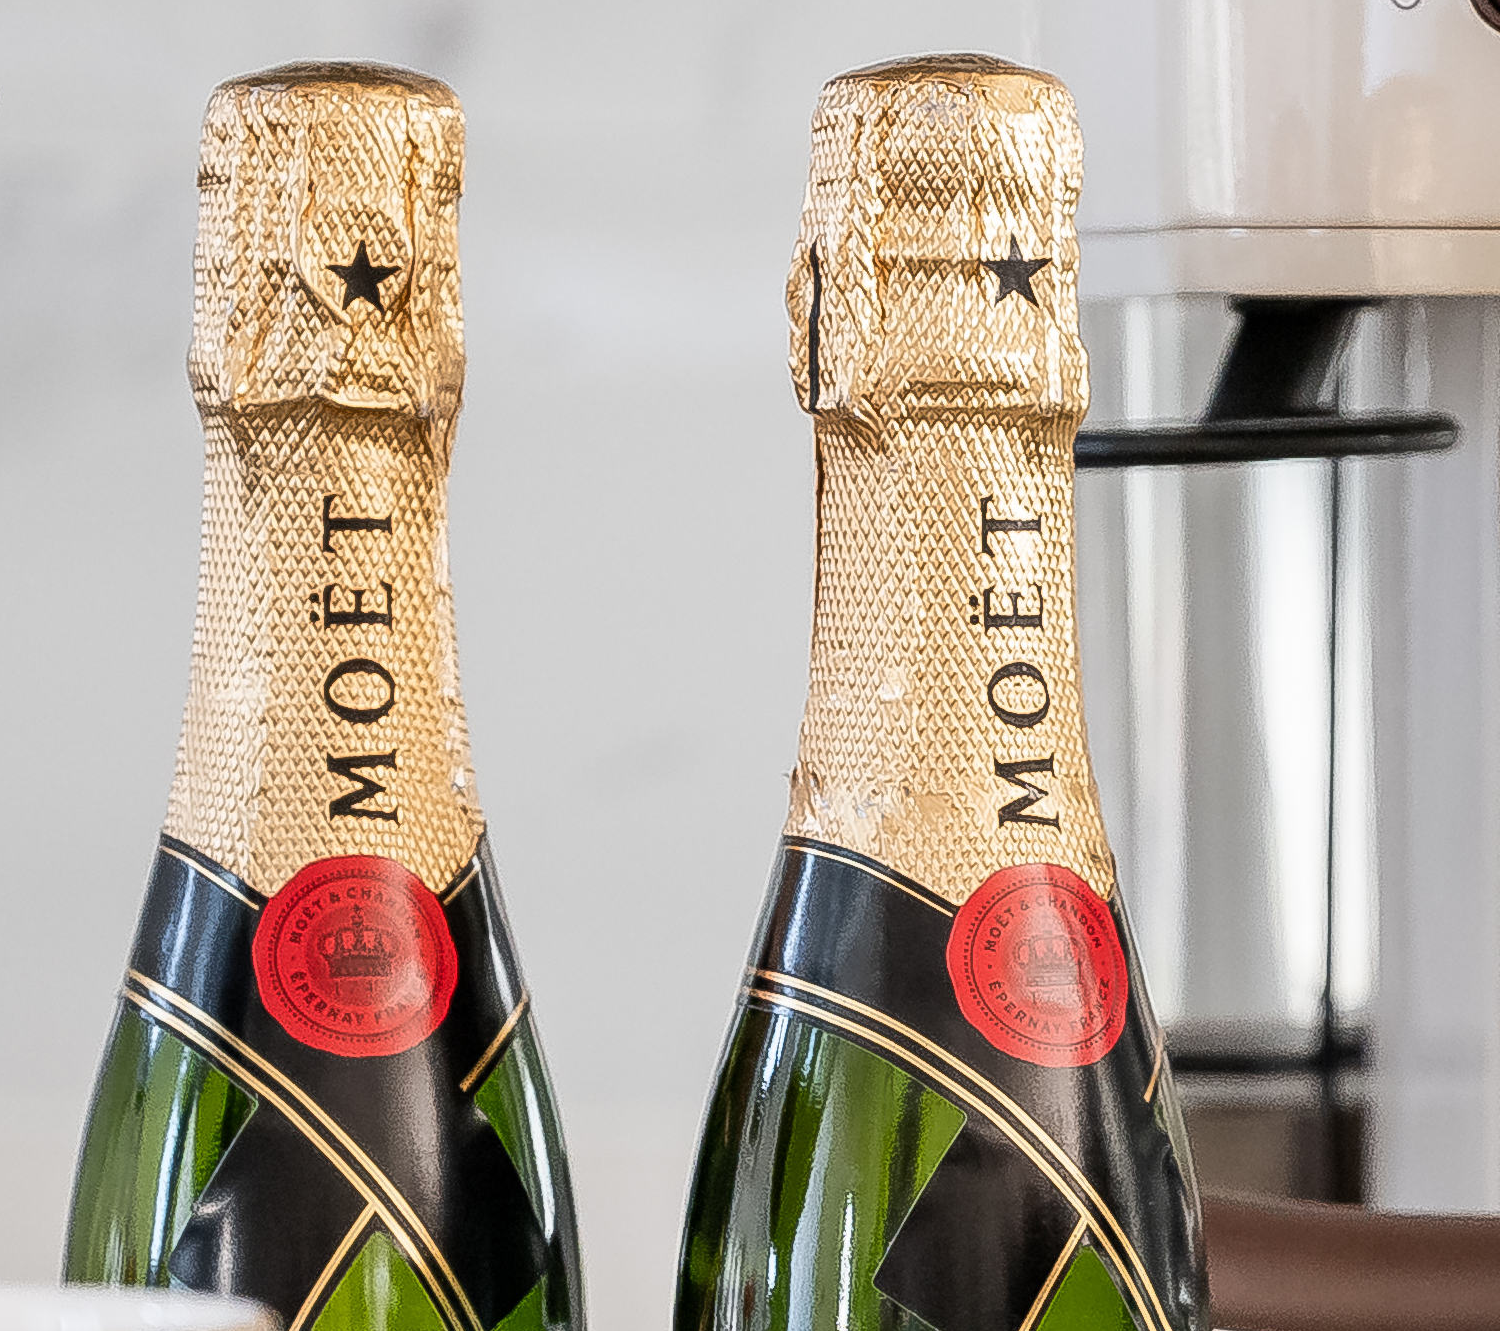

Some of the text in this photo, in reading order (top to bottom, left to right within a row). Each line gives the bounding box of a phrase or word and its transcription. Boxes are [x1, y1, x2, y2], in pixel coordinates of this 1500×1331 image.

[308, 493, 400, 826] MOËT
[968, 494, 1062, 833] MOËT
[1034, 894, 1103, 950] CHANDON
